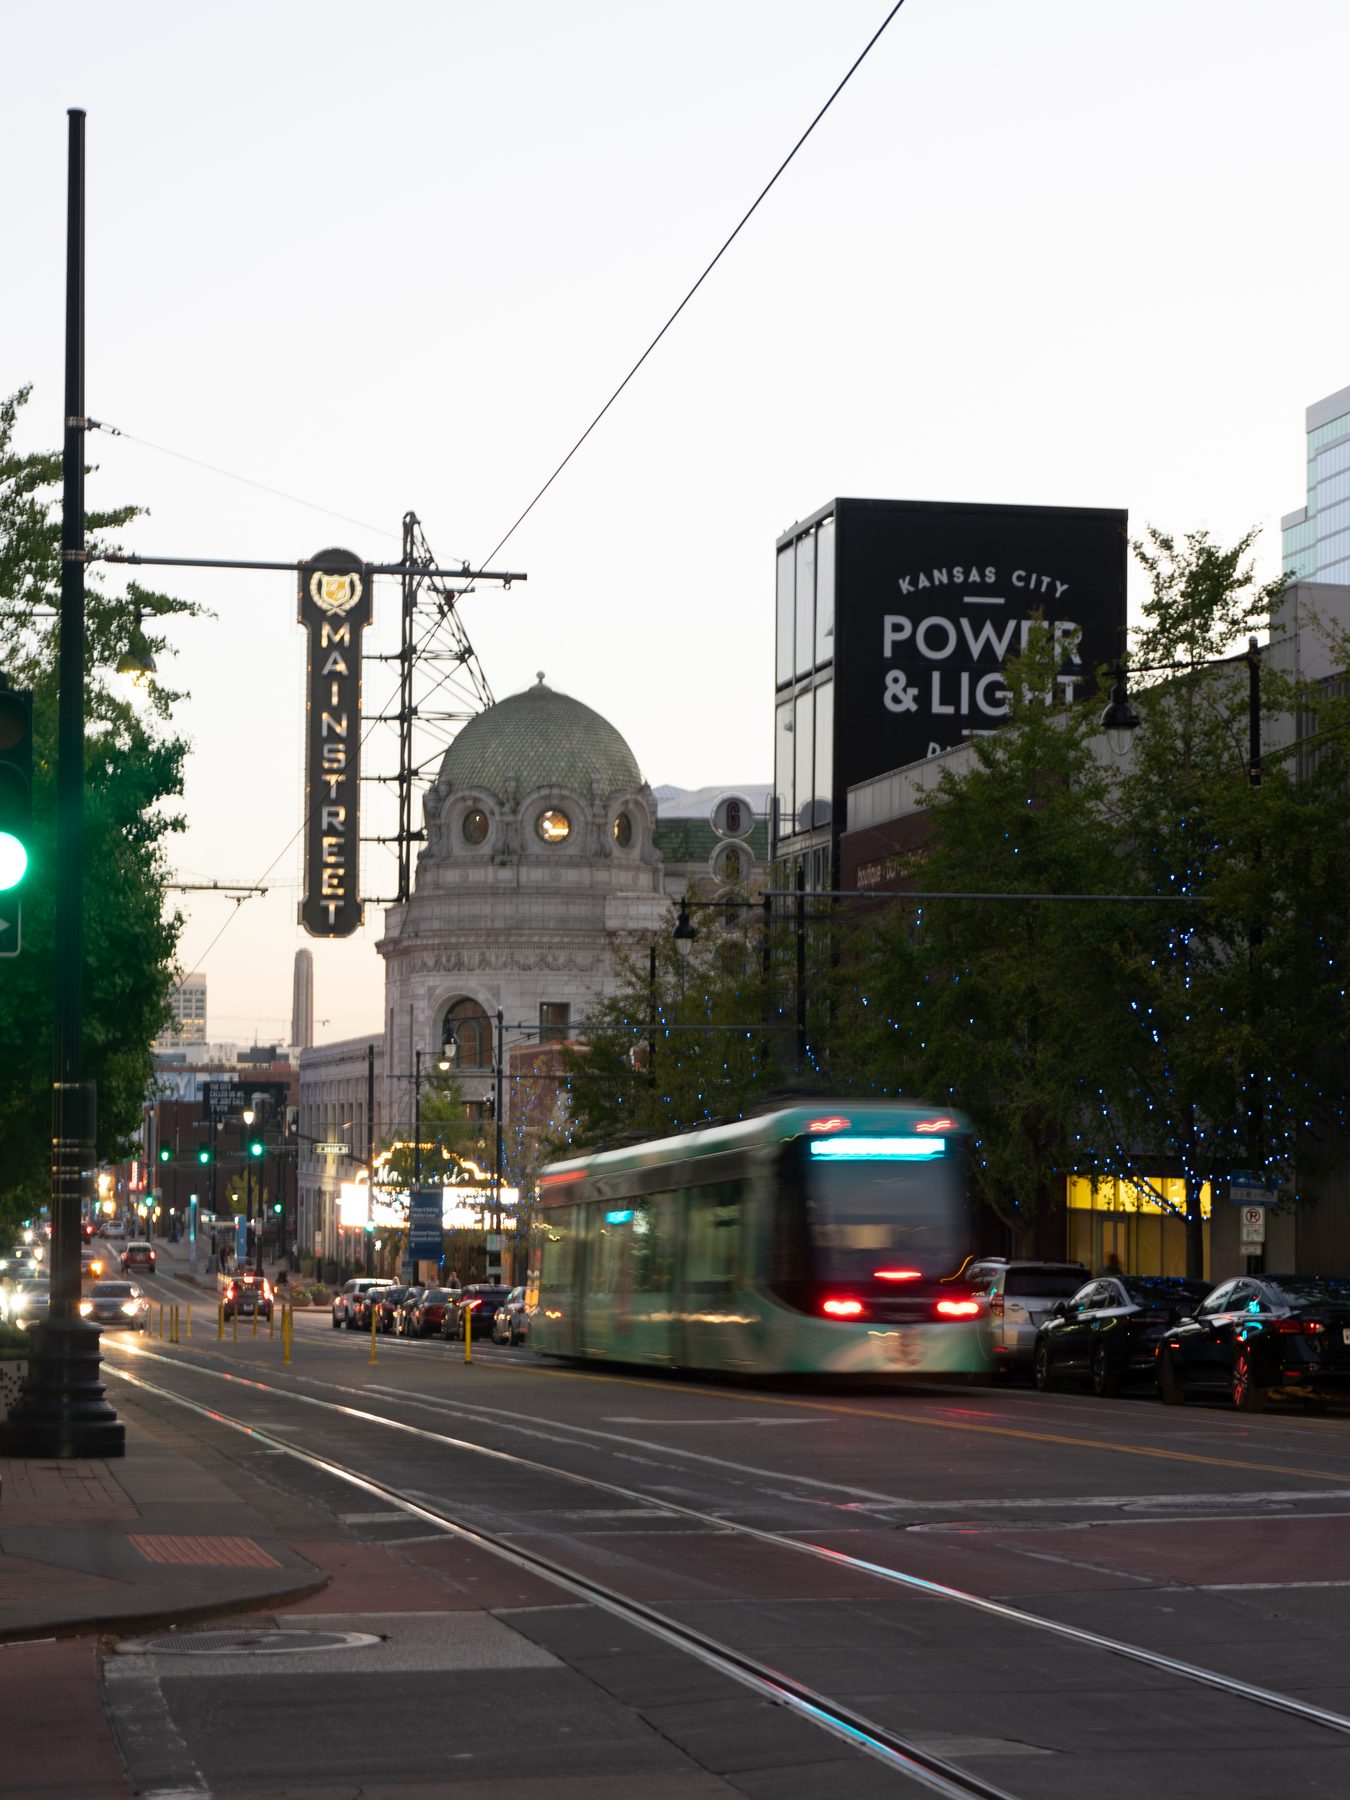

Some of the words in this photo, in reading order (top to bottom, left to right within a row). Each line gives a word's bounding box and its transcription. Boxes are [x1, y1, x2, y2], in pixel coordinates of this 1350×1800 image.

[898, 565, 996, 595] KANSAS
[1011, 569, 1070, 599] CITY
[883, 668, 919, 714] &
